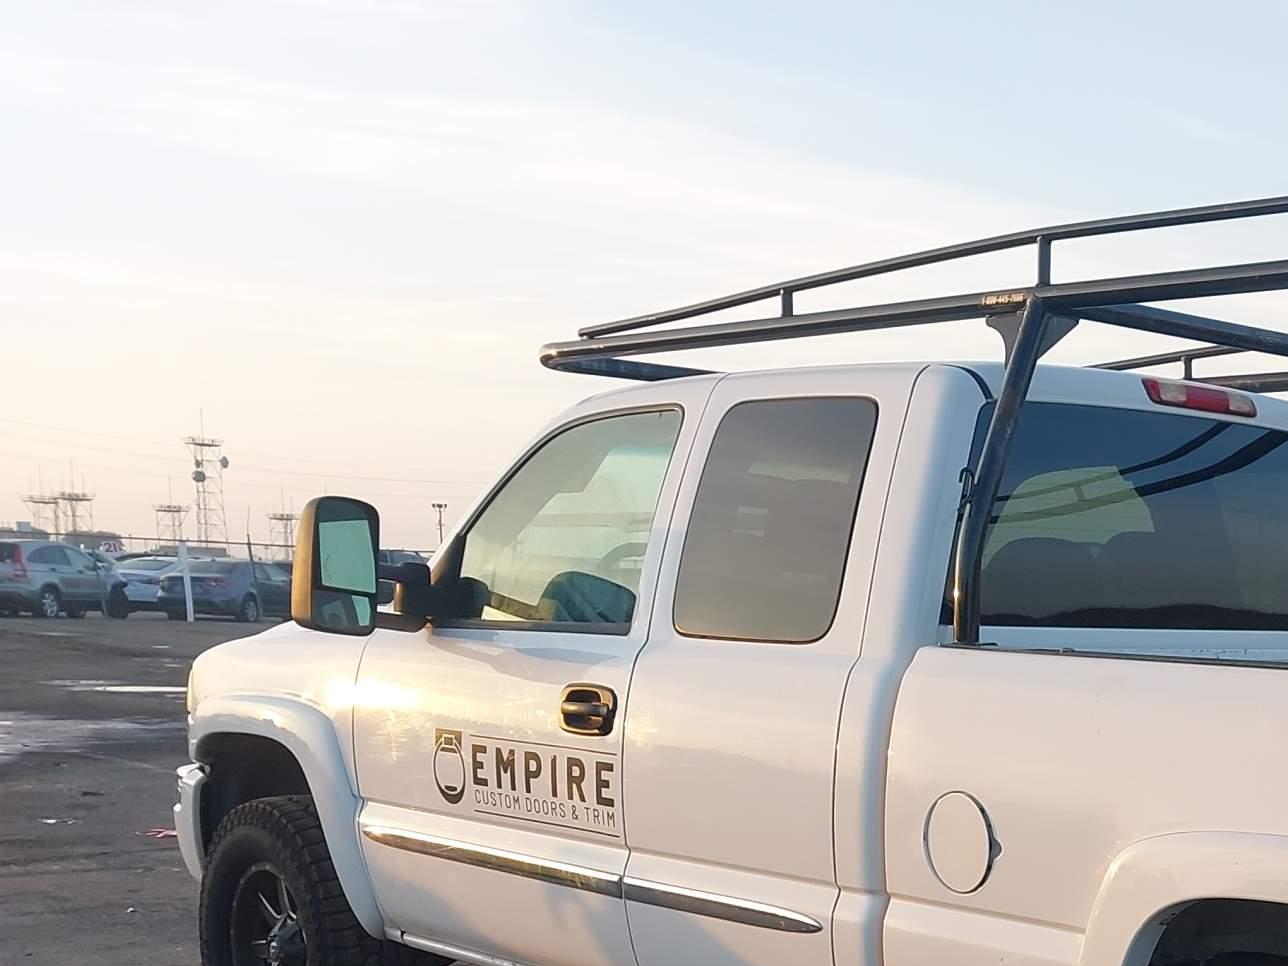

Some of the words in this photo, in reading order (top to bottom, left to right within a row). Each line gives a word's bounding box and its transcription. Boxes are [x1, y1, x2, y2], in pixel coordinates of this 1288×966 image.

[471, 743, 615, 808] EMPIRE
[474, 789, 521, 811] CUSTOM
[525, 797, 566, 819] DOORS
[571, 806, 579, 820] &
[583, 807, 616, 828] TRIM
